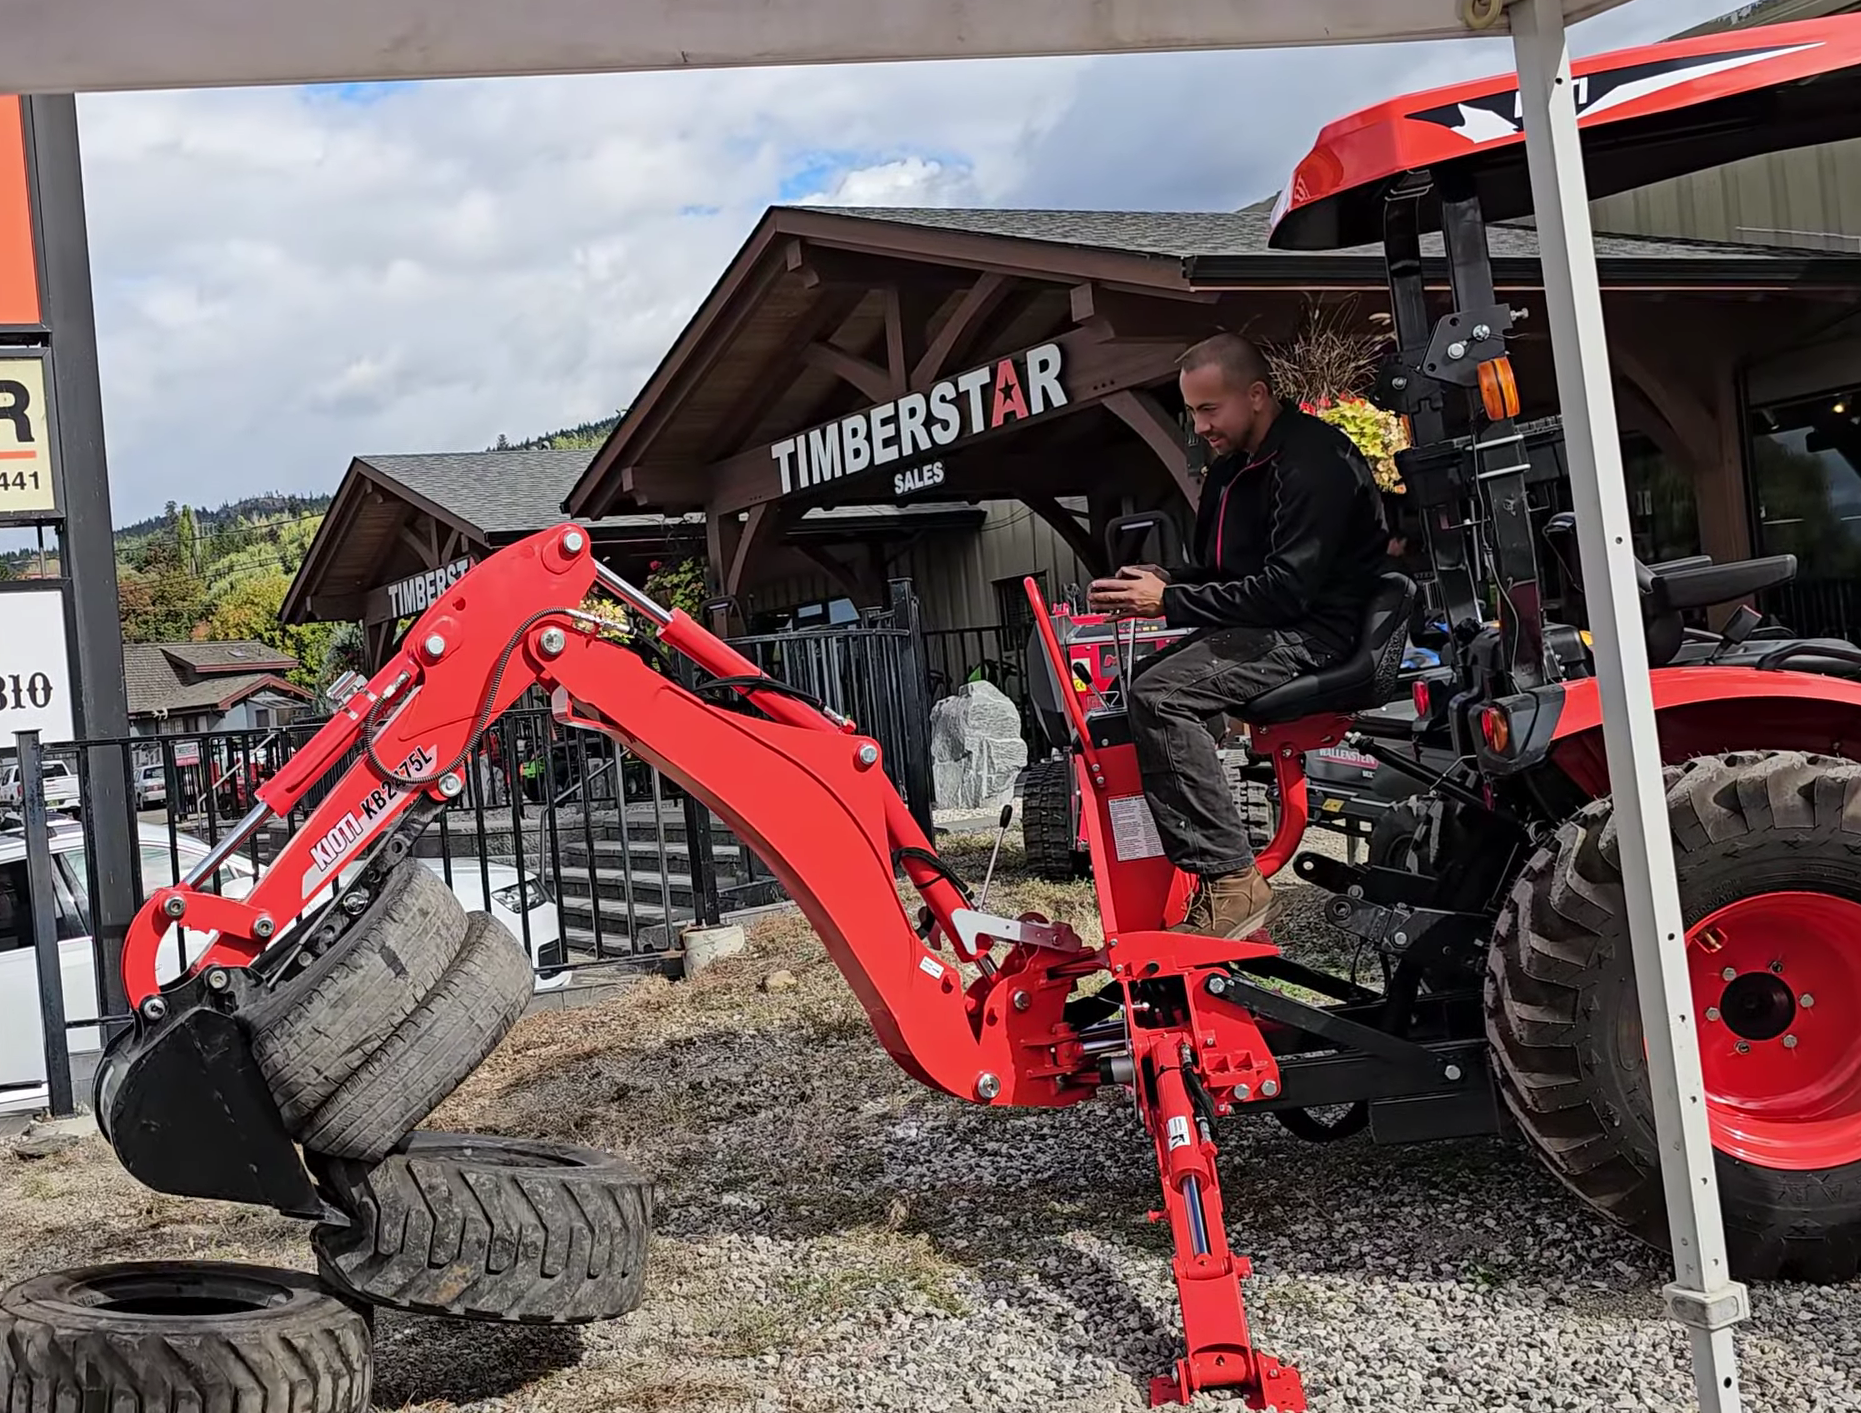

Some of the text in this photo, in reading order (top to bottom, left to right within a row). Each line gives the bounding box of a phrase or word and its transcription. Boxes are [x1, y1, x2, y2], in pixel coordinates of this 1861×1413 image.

[771, 343, 1068, 494] TIMBERSTAR
[894, 461, 945, 495] SALES
[309, 810, 364, 872] KIOTI
